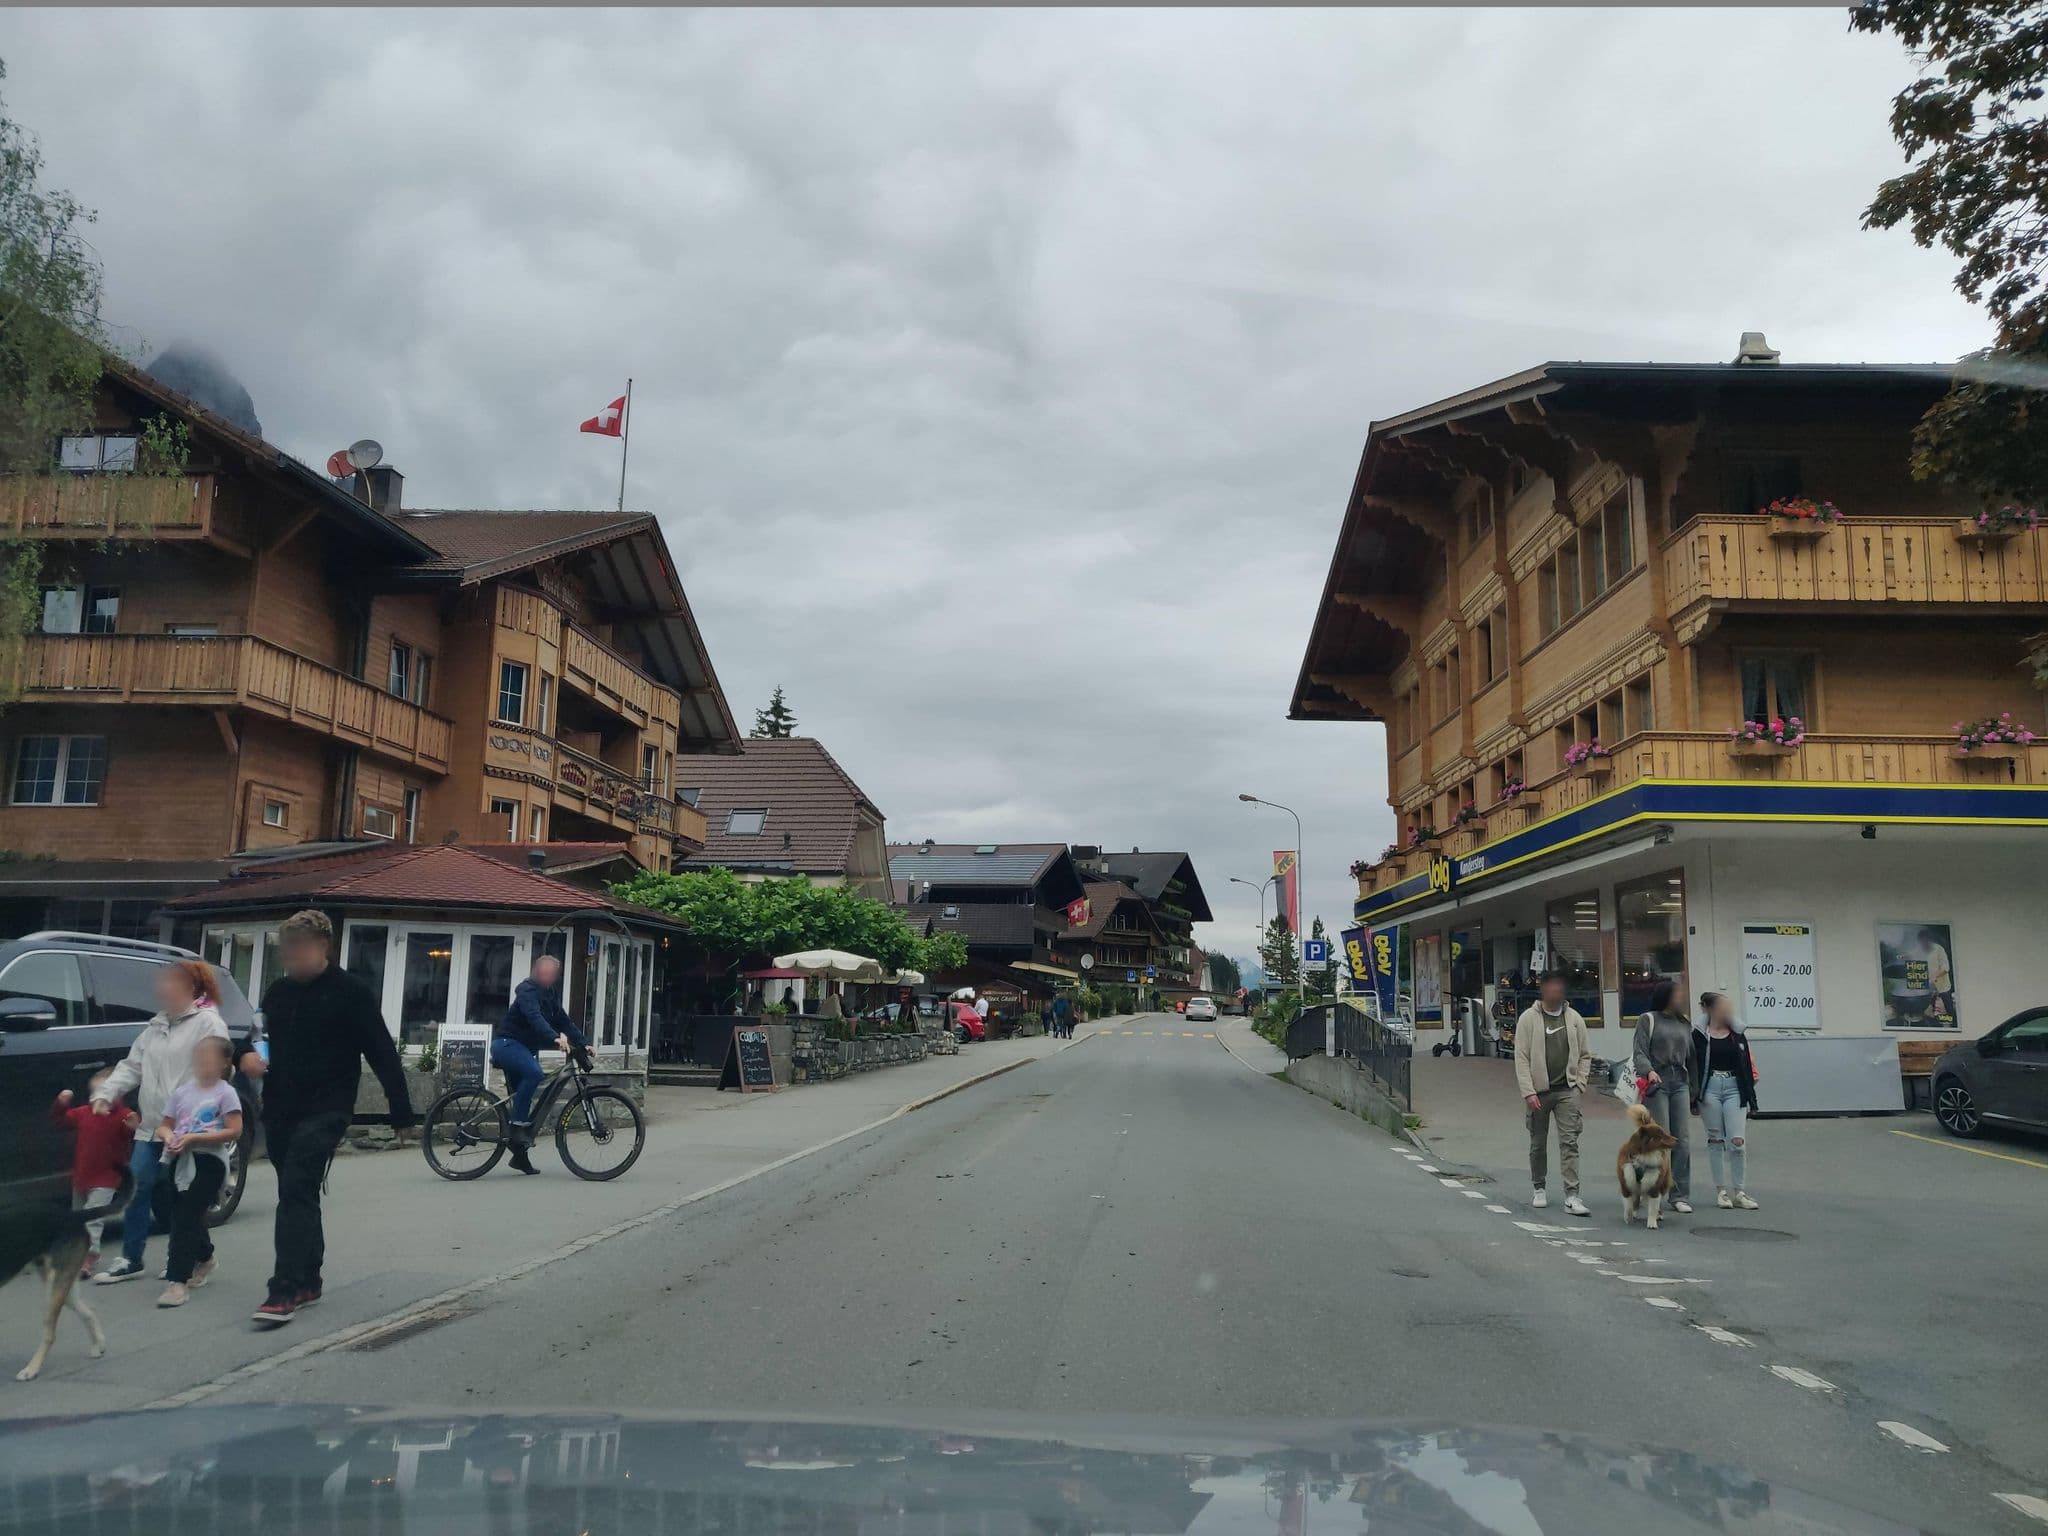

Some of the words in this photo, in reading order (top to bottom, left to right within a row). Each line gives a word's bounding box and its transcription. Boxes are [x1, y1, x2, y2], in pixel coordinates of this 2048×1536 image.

[1428, 856, 1450, 893] Volg
[1776, 926, 1803, 935] Volg
[1310, 944, 1320, 959] P
[1374, 935, 1391, 976] Volg
[1347, 940, 1368, 980] Volg
[1906, 961, 1927, 971] Hier
[1752, 963, 1774, 975] 6.00
[1783, 964, 1812, 975] 20.00
[1907, 971, 1928, 980] sind
[1753, 996, 1776, 1007] 7.00
[1785, 997, 1814, 1008] 20.00
